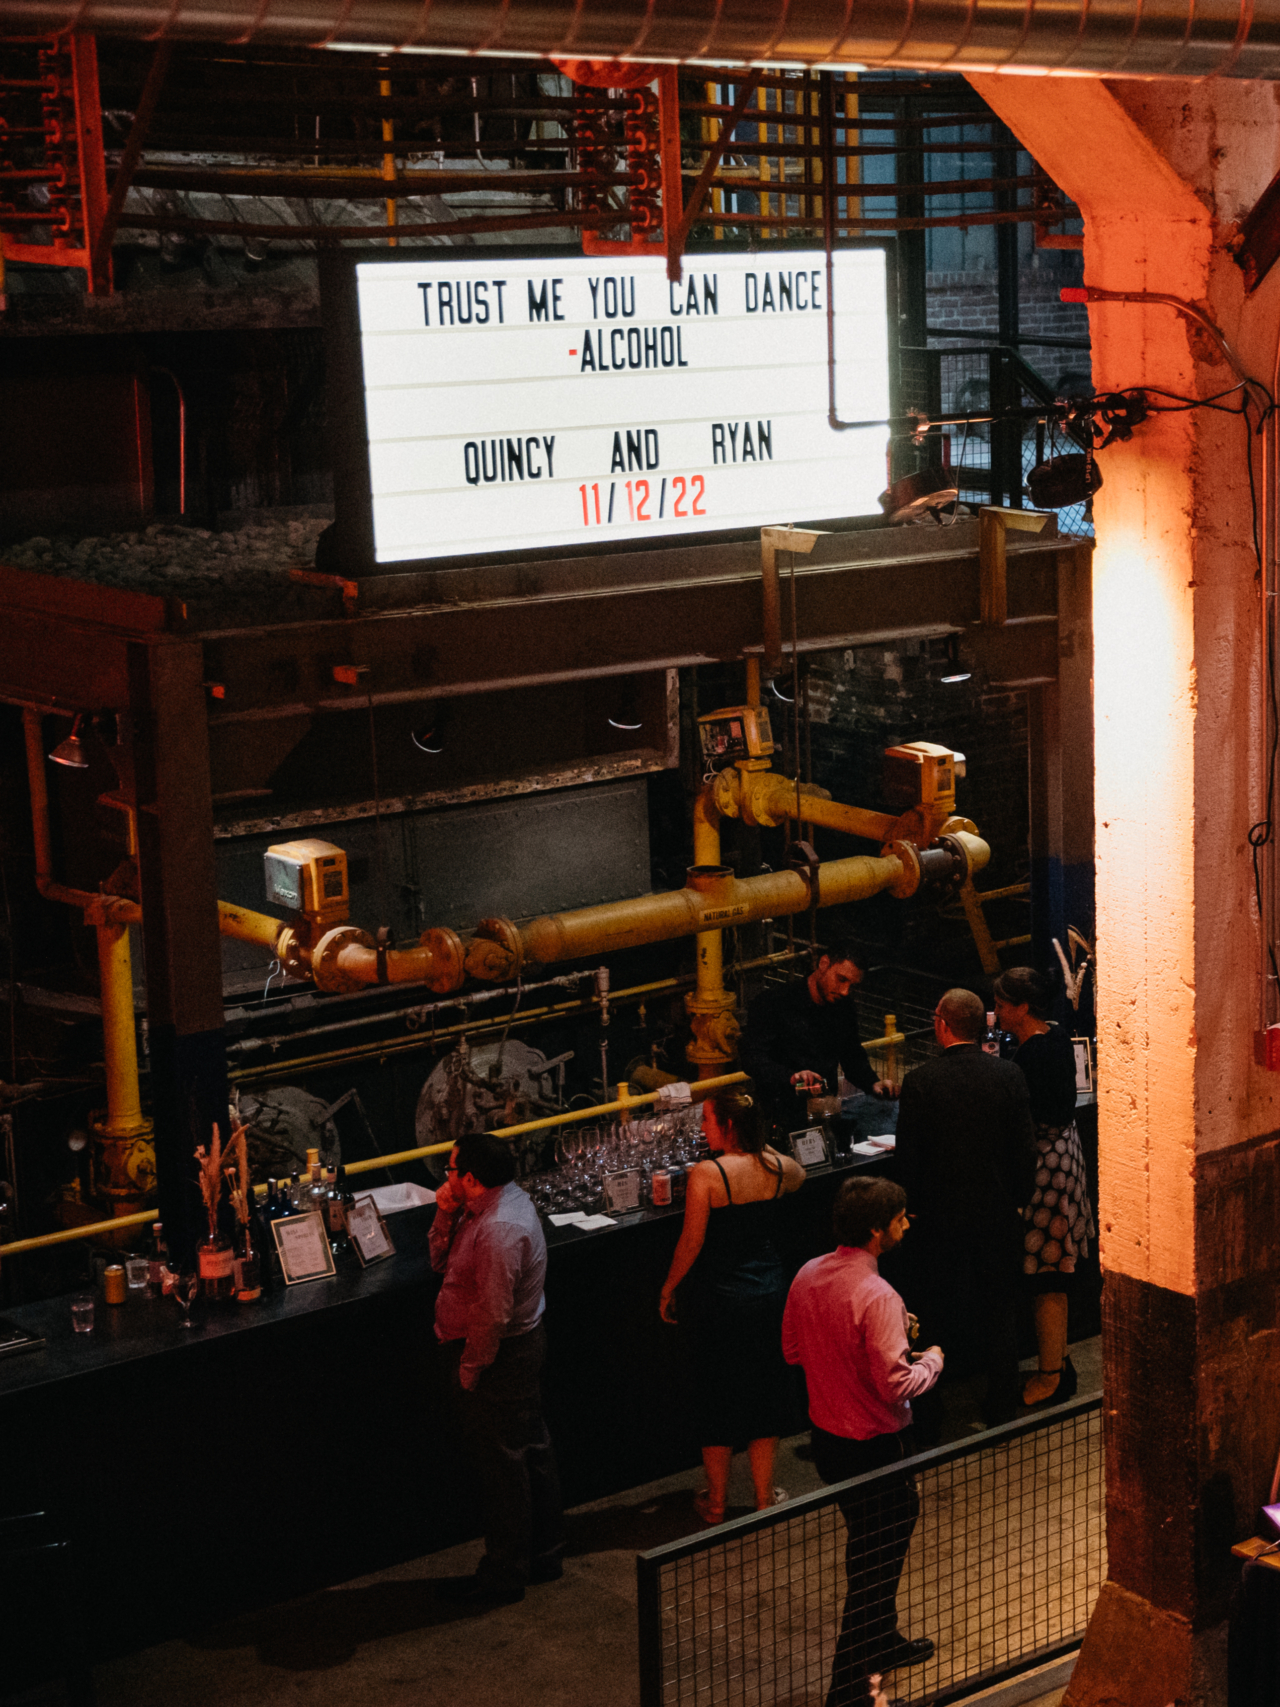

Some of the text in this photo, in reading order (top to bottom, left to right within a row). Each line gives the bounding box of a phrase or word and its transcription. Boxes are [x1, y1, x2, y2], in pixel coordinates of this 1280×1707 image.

[418, 270, 822, 327] TRUST ME YOU CAN DANCE
[569, 325, 689, 373] -ALCOHOL
[464, 419, 773, 487] QUINCY AND RYAN
[703, 905, 744, 922] NATURAL GAS
